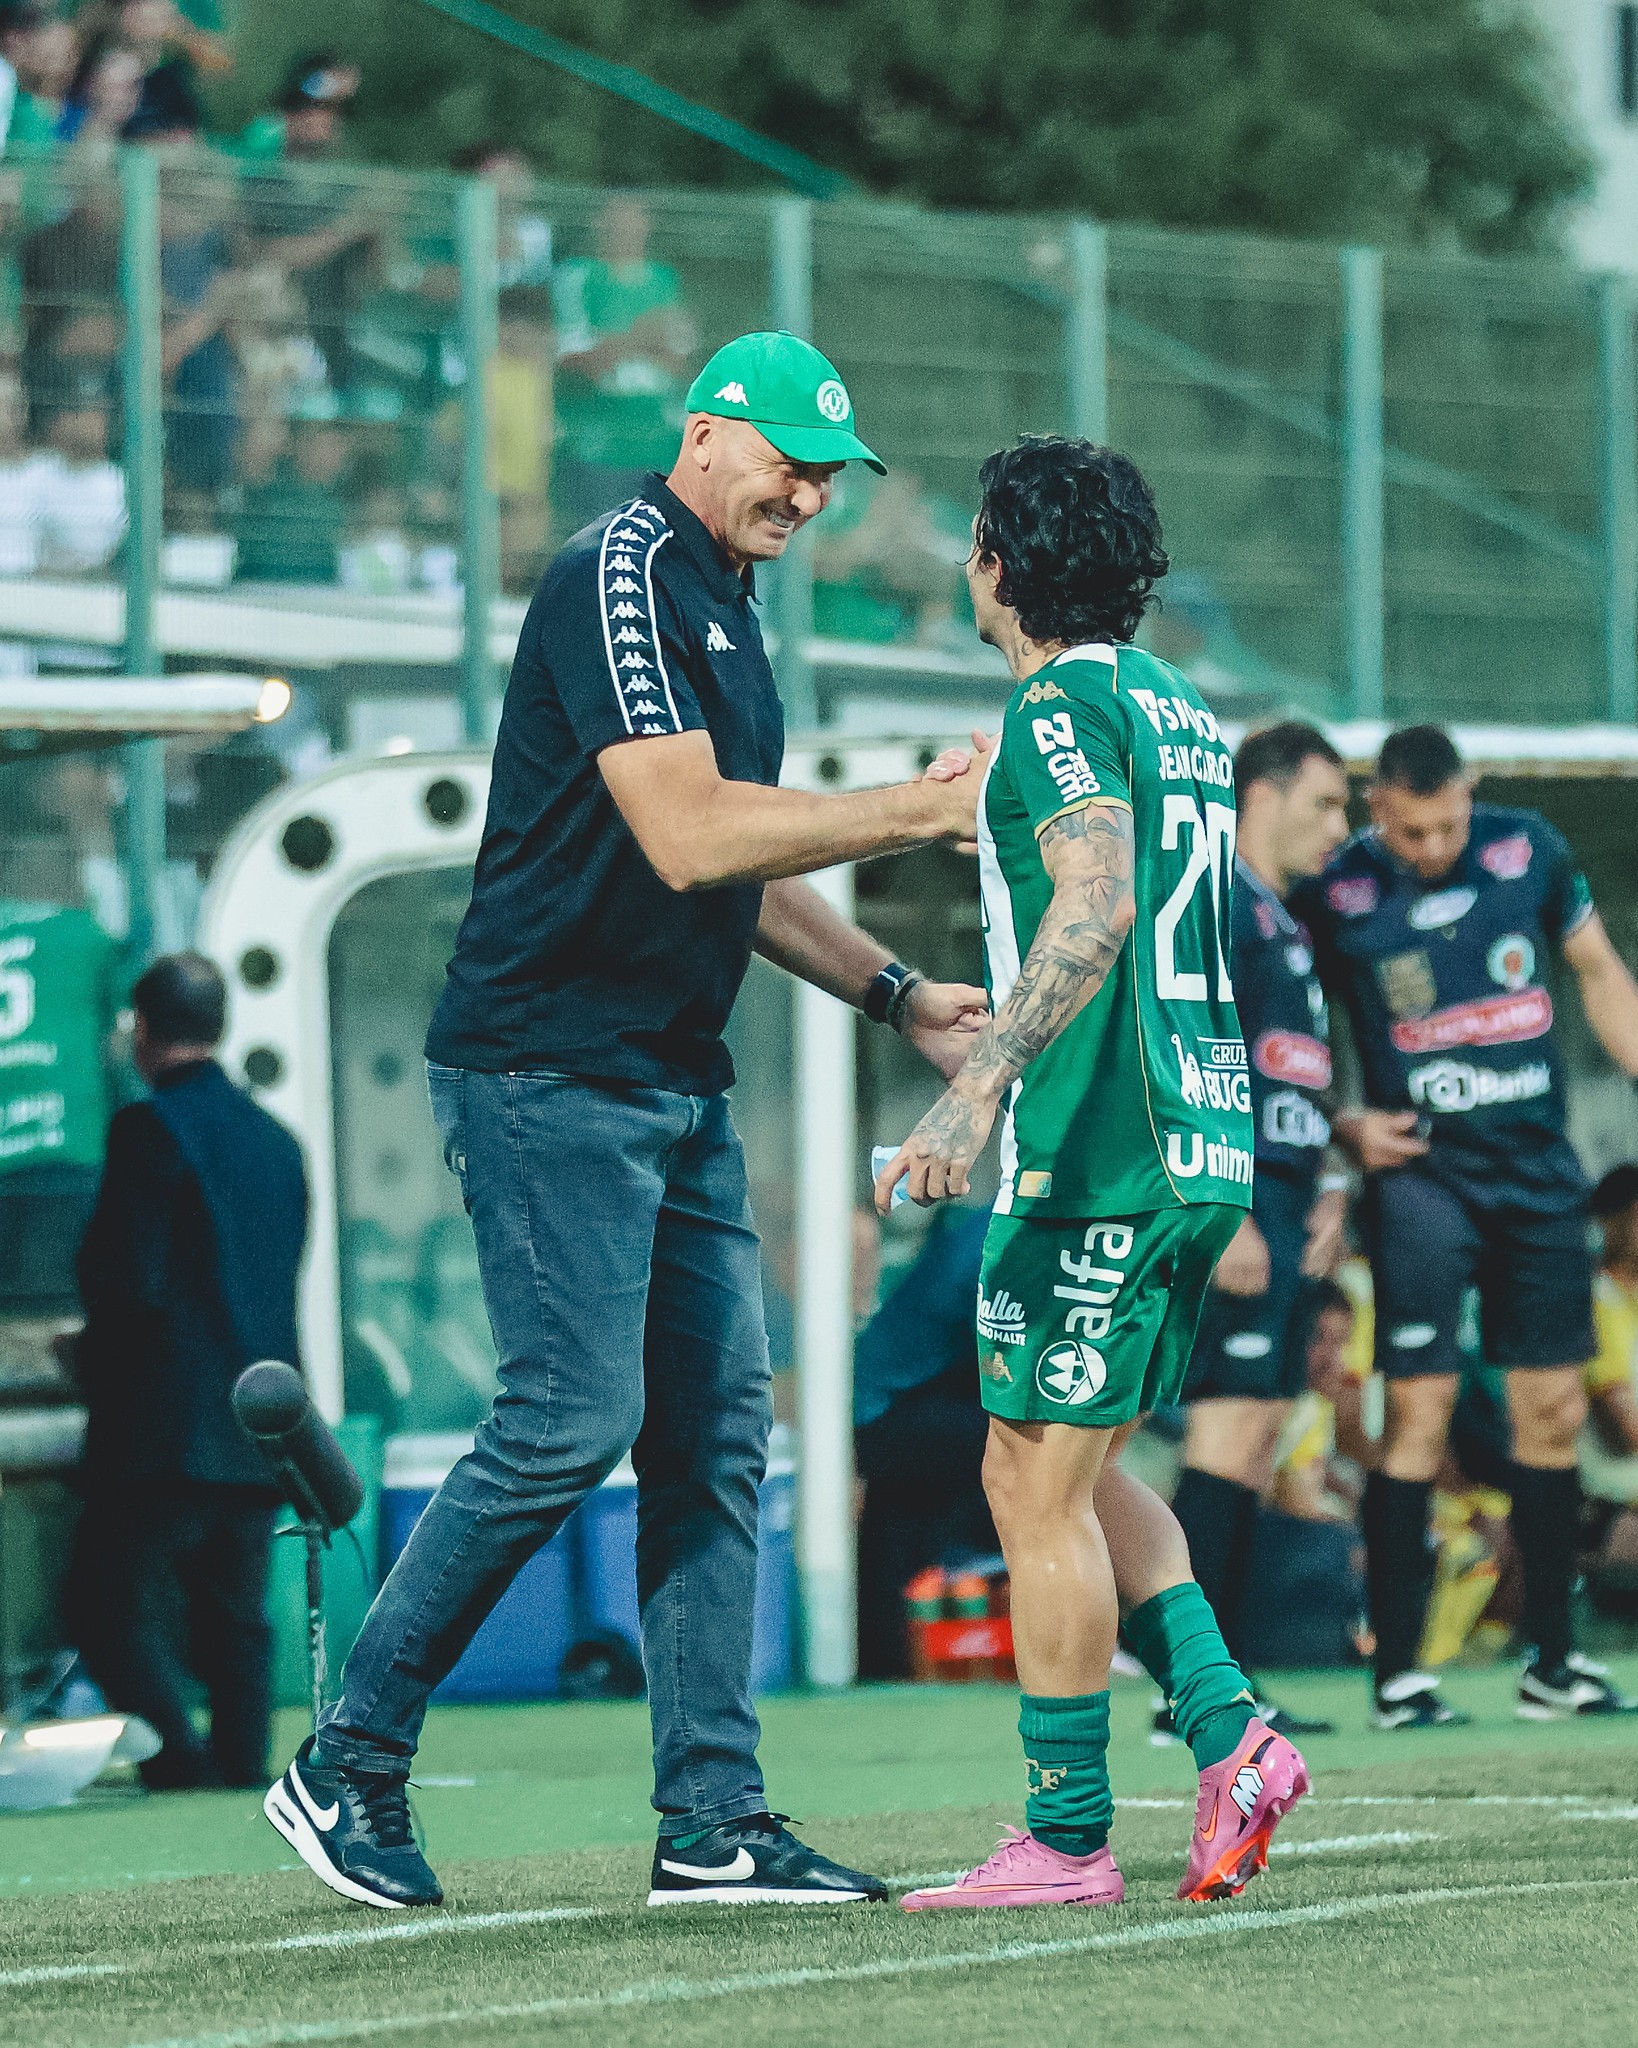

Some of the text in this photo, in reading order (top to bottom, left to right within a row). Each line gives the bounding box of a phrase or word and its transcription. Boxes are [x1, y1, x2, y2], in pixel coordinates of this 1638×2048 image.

[1047, 752, 1085, 804] um
[1066, 747, 1101, 794] zero
[1154, 793, 1237, 1003] 20
[1201, 1069, 1253, 1114] BUG
[1053, 1221, 1135, 1340] alfa
[993, 1329, 1027, 1347] MALTE
